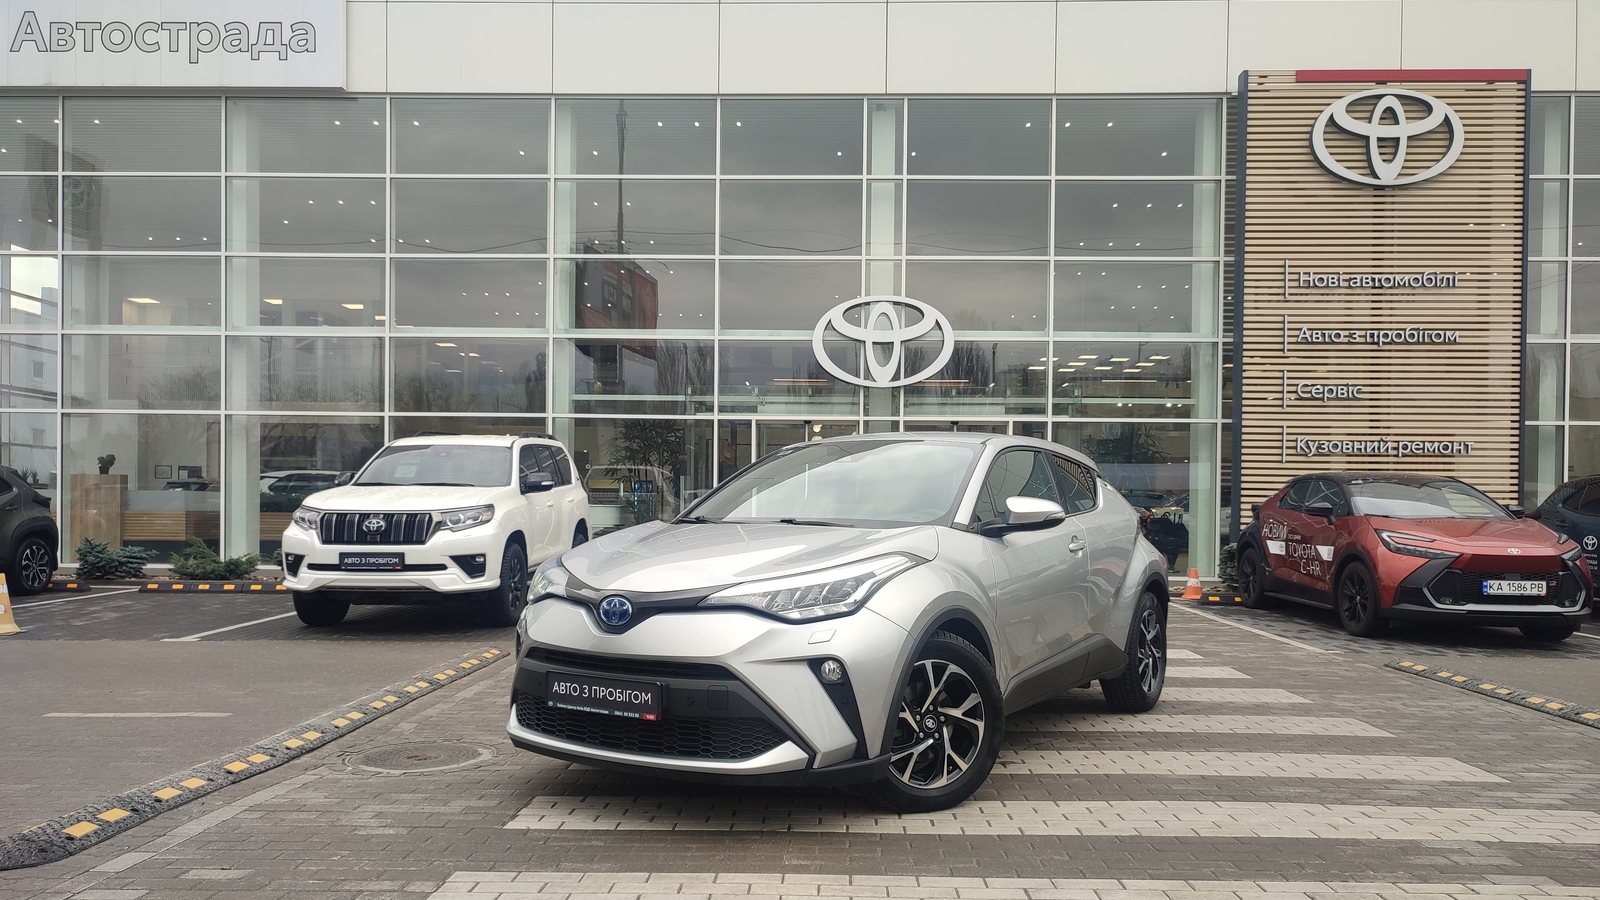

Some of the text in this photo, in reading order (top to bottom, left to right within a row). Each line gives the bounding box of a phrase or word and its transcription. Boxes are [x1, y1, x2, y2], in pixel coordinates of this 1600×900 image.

[9, 10, 317, 64] Автострада
[1299, 270, 1458, 287] Нові автомобілі
[1297, 326, 1459, 347] Авто з пробігом
[1297, 382, 1363, 402] Сервіс
[1296, 436, 1474, 458] Кузовний ремонт
[1288, 542, 1317, 559] TOYOTA
[1300, 559, 1321, 576] C-HR
[1488, 582, 1503, 592] KA
[1506, 582, 1528, 592] 1586
[1530, 583, 1544, 593] PB
[552, 681, 652, 705] АВТО З ПРОБІГОМ
